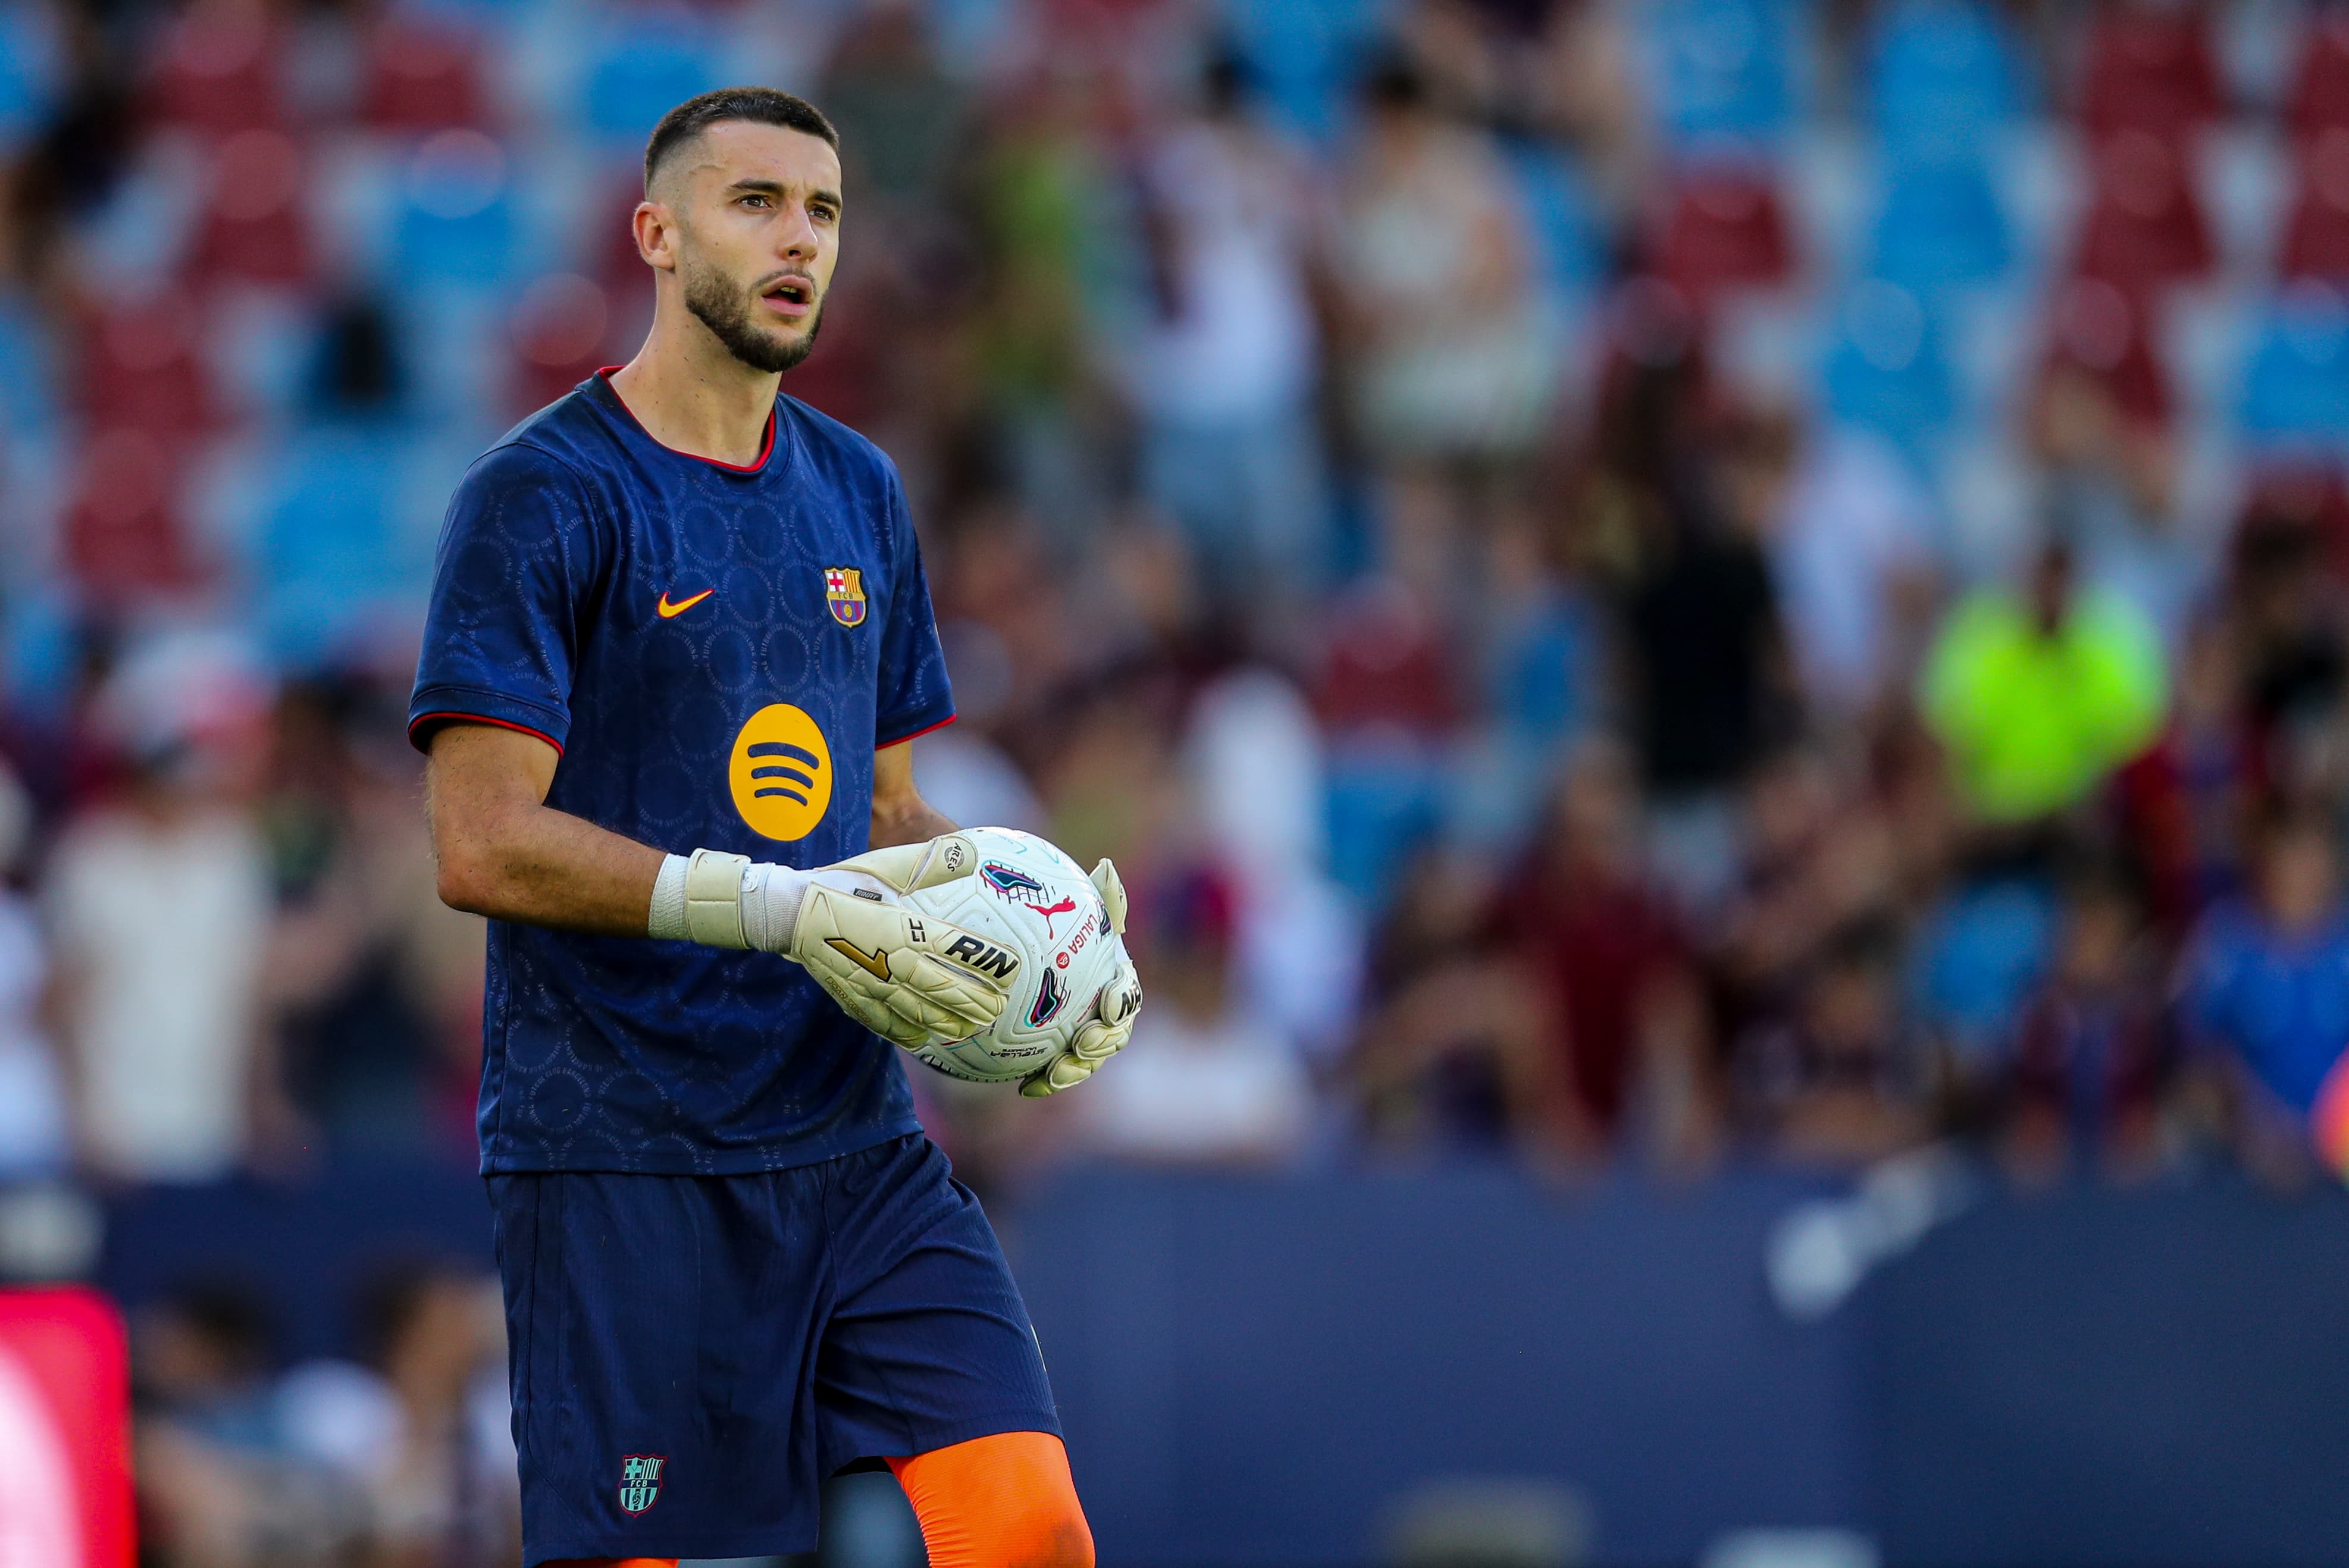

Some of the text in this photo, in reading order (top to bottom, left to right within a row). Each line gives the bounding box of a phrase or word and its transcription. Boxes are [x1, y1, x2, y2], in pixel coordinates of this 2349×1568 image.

[947, 842, 962, 872] ARES
[855, 889, 879, 900] RINAT
[1068, 914, 1098, 954] LALIGA
[944, 934, 1019, 979] RIN
[990, 1047, 1048, 1058] STELLAR
